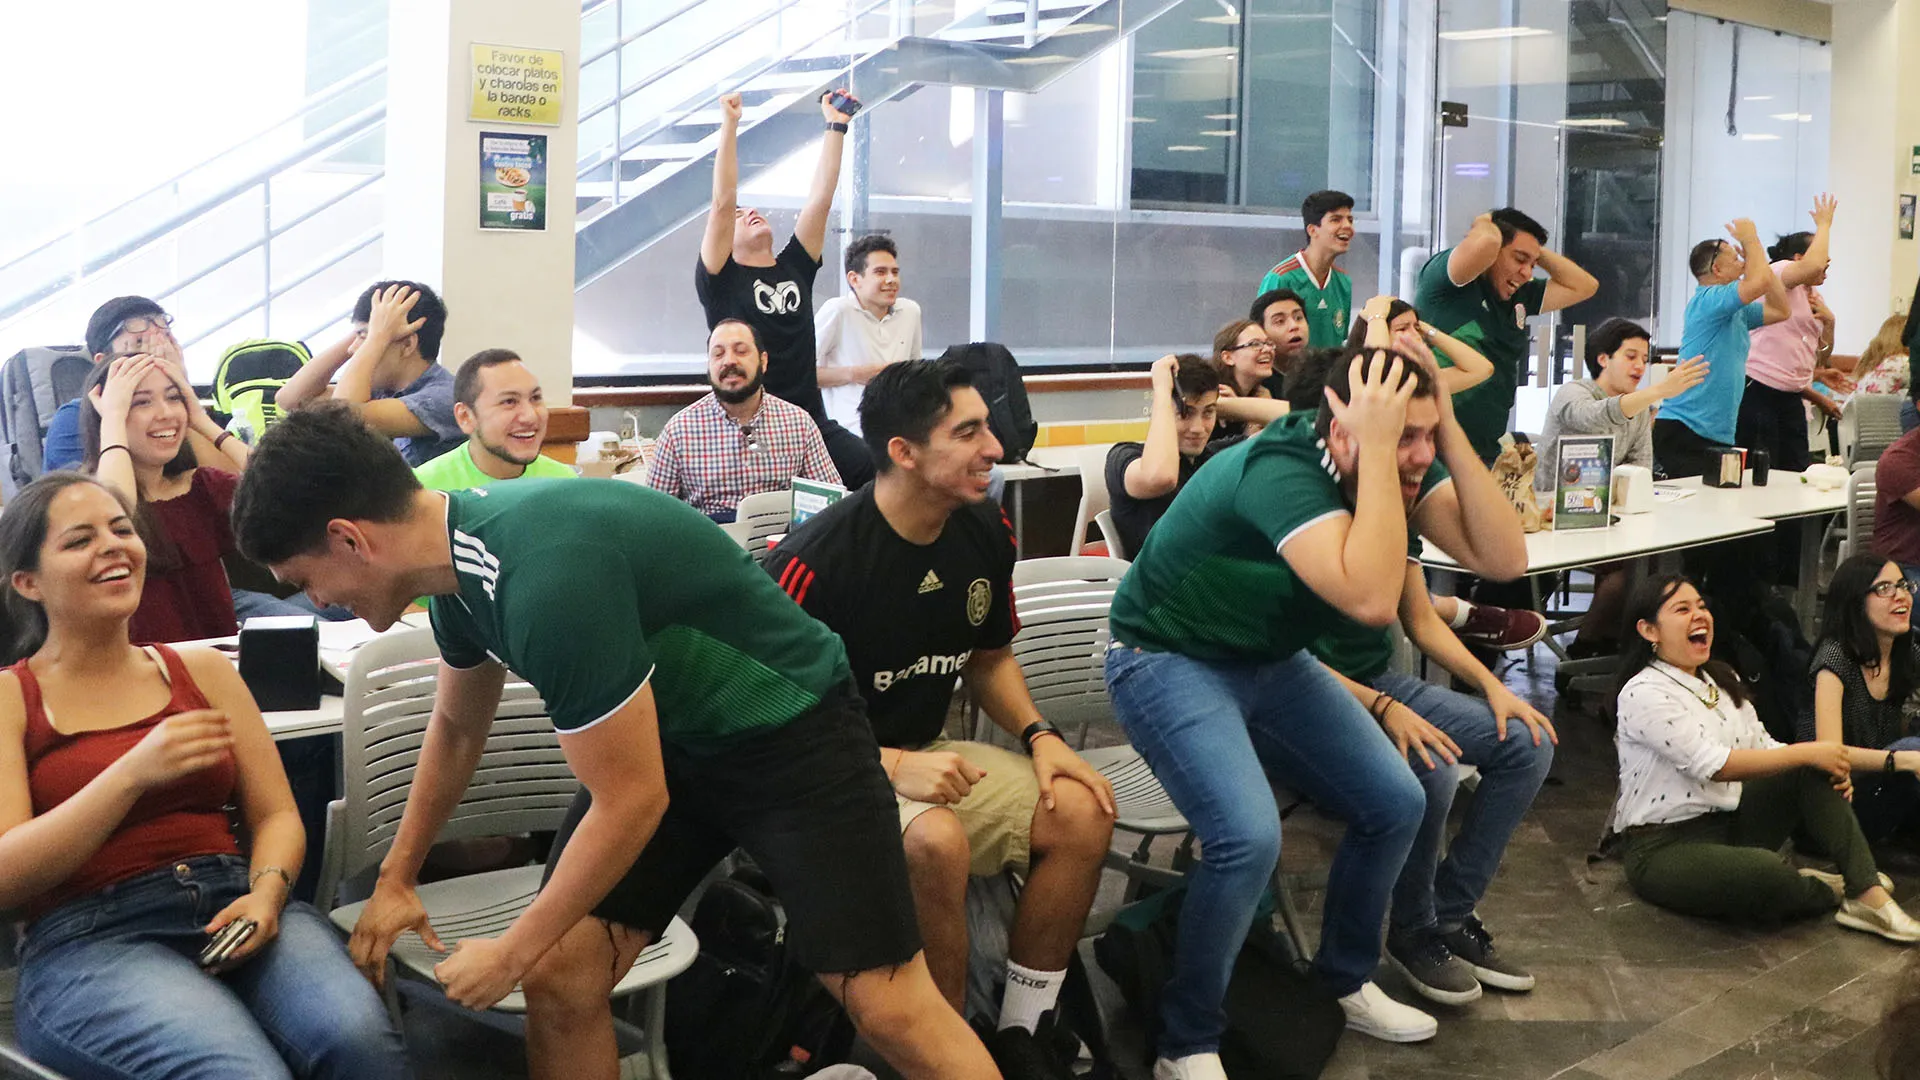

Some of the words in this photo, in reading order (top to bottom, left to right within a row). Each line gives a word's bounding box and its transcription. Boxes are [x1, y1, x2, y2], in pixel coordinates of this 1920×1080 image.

[492, 50, 525, 63] Favor
[529, 54, 543, 65] de
[477, 64, 520, 77] colocar
[523, 67, 558, 80] platos
[480, 78, 486, 90] y
[490, 77, 539, 92] charolas
[542, 83, 557, 92] en
[487, 90, 497, 102] la
[500, 91, 536, 105] banda
[539, 96, 547, 106] o
